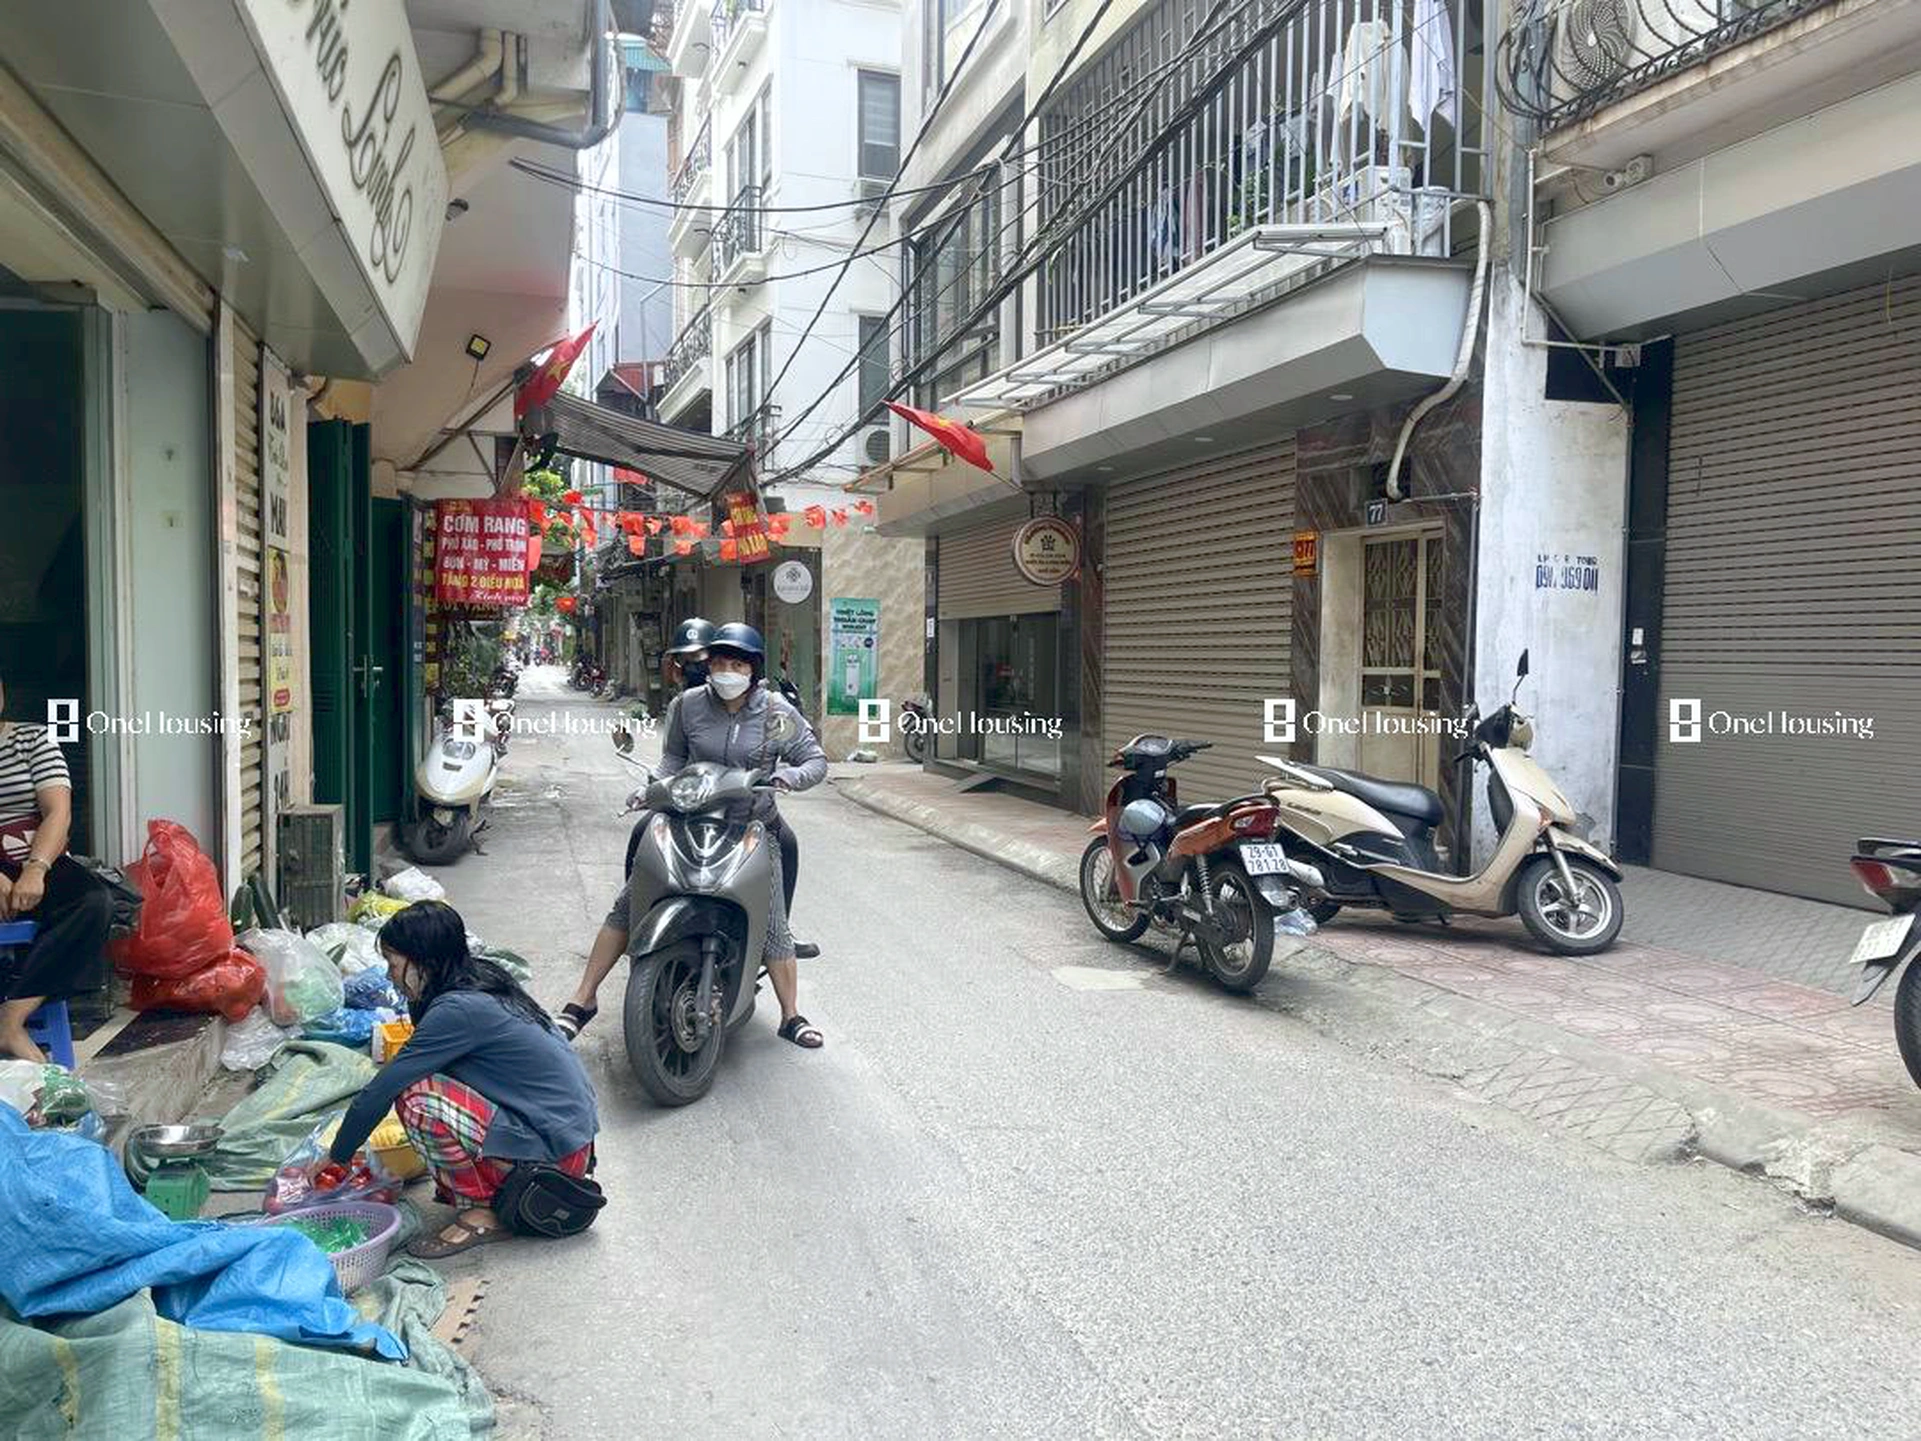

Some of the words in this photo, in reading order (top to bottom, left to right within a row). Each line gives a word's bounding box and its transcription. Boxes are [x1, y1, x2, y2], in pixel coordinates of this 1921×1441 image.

[1368, 504, 1384, 523] 77
[443, 513, 479, 533] CƠM
[484, 515, 526, 535] RANG
[470, 575, 478, 588] 2
